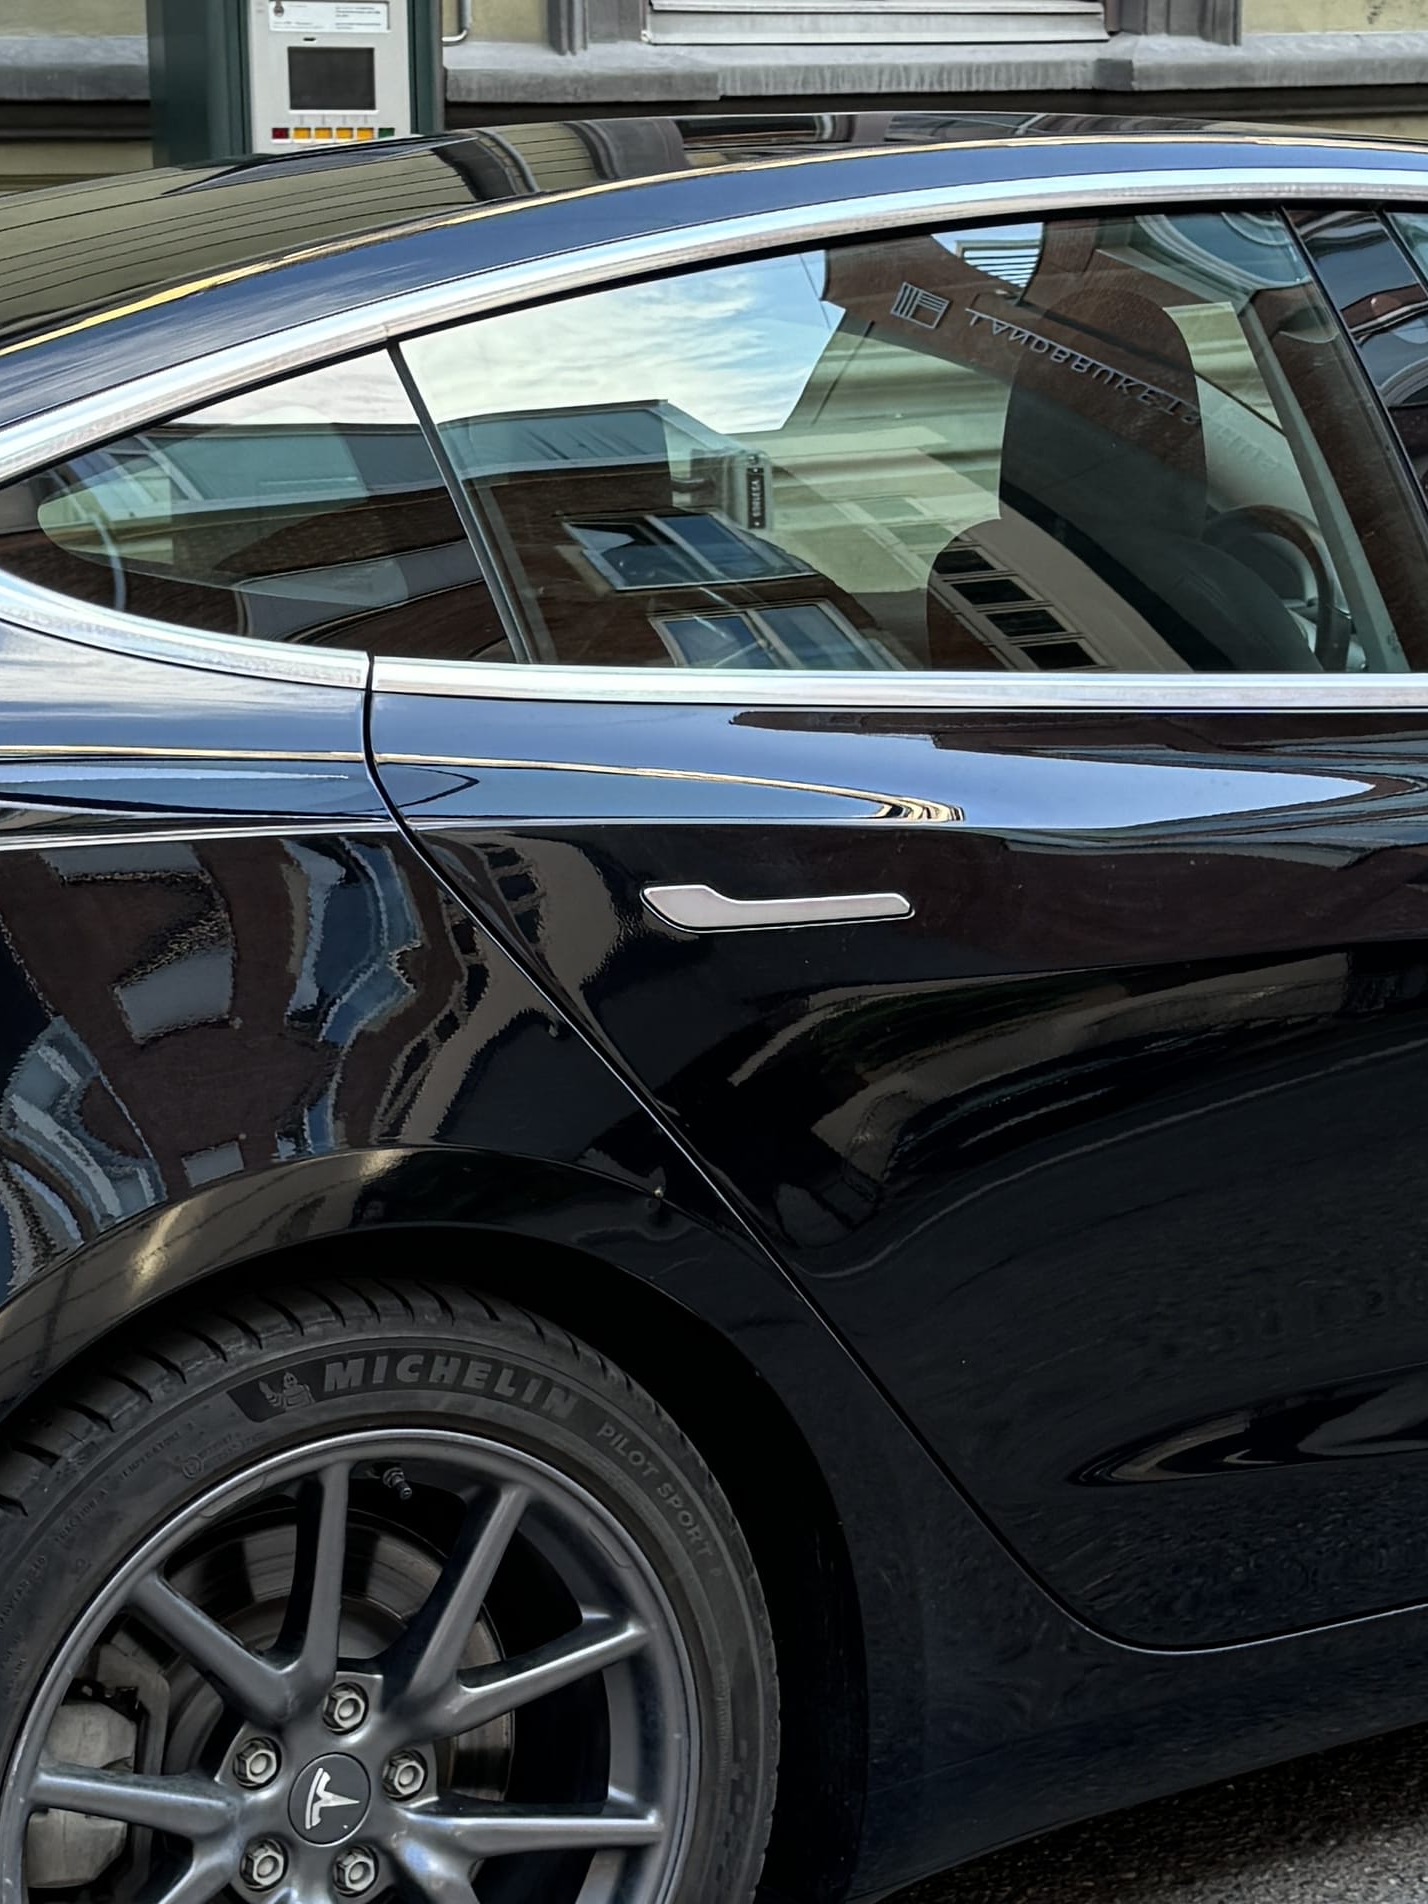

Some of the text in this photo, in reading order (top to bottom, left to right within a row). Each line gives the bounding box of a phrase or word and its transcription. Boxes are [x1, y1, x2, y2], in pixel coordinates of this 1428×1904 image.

[323, 1354, 714, 1560] MICHELIN PILOT SPORT
